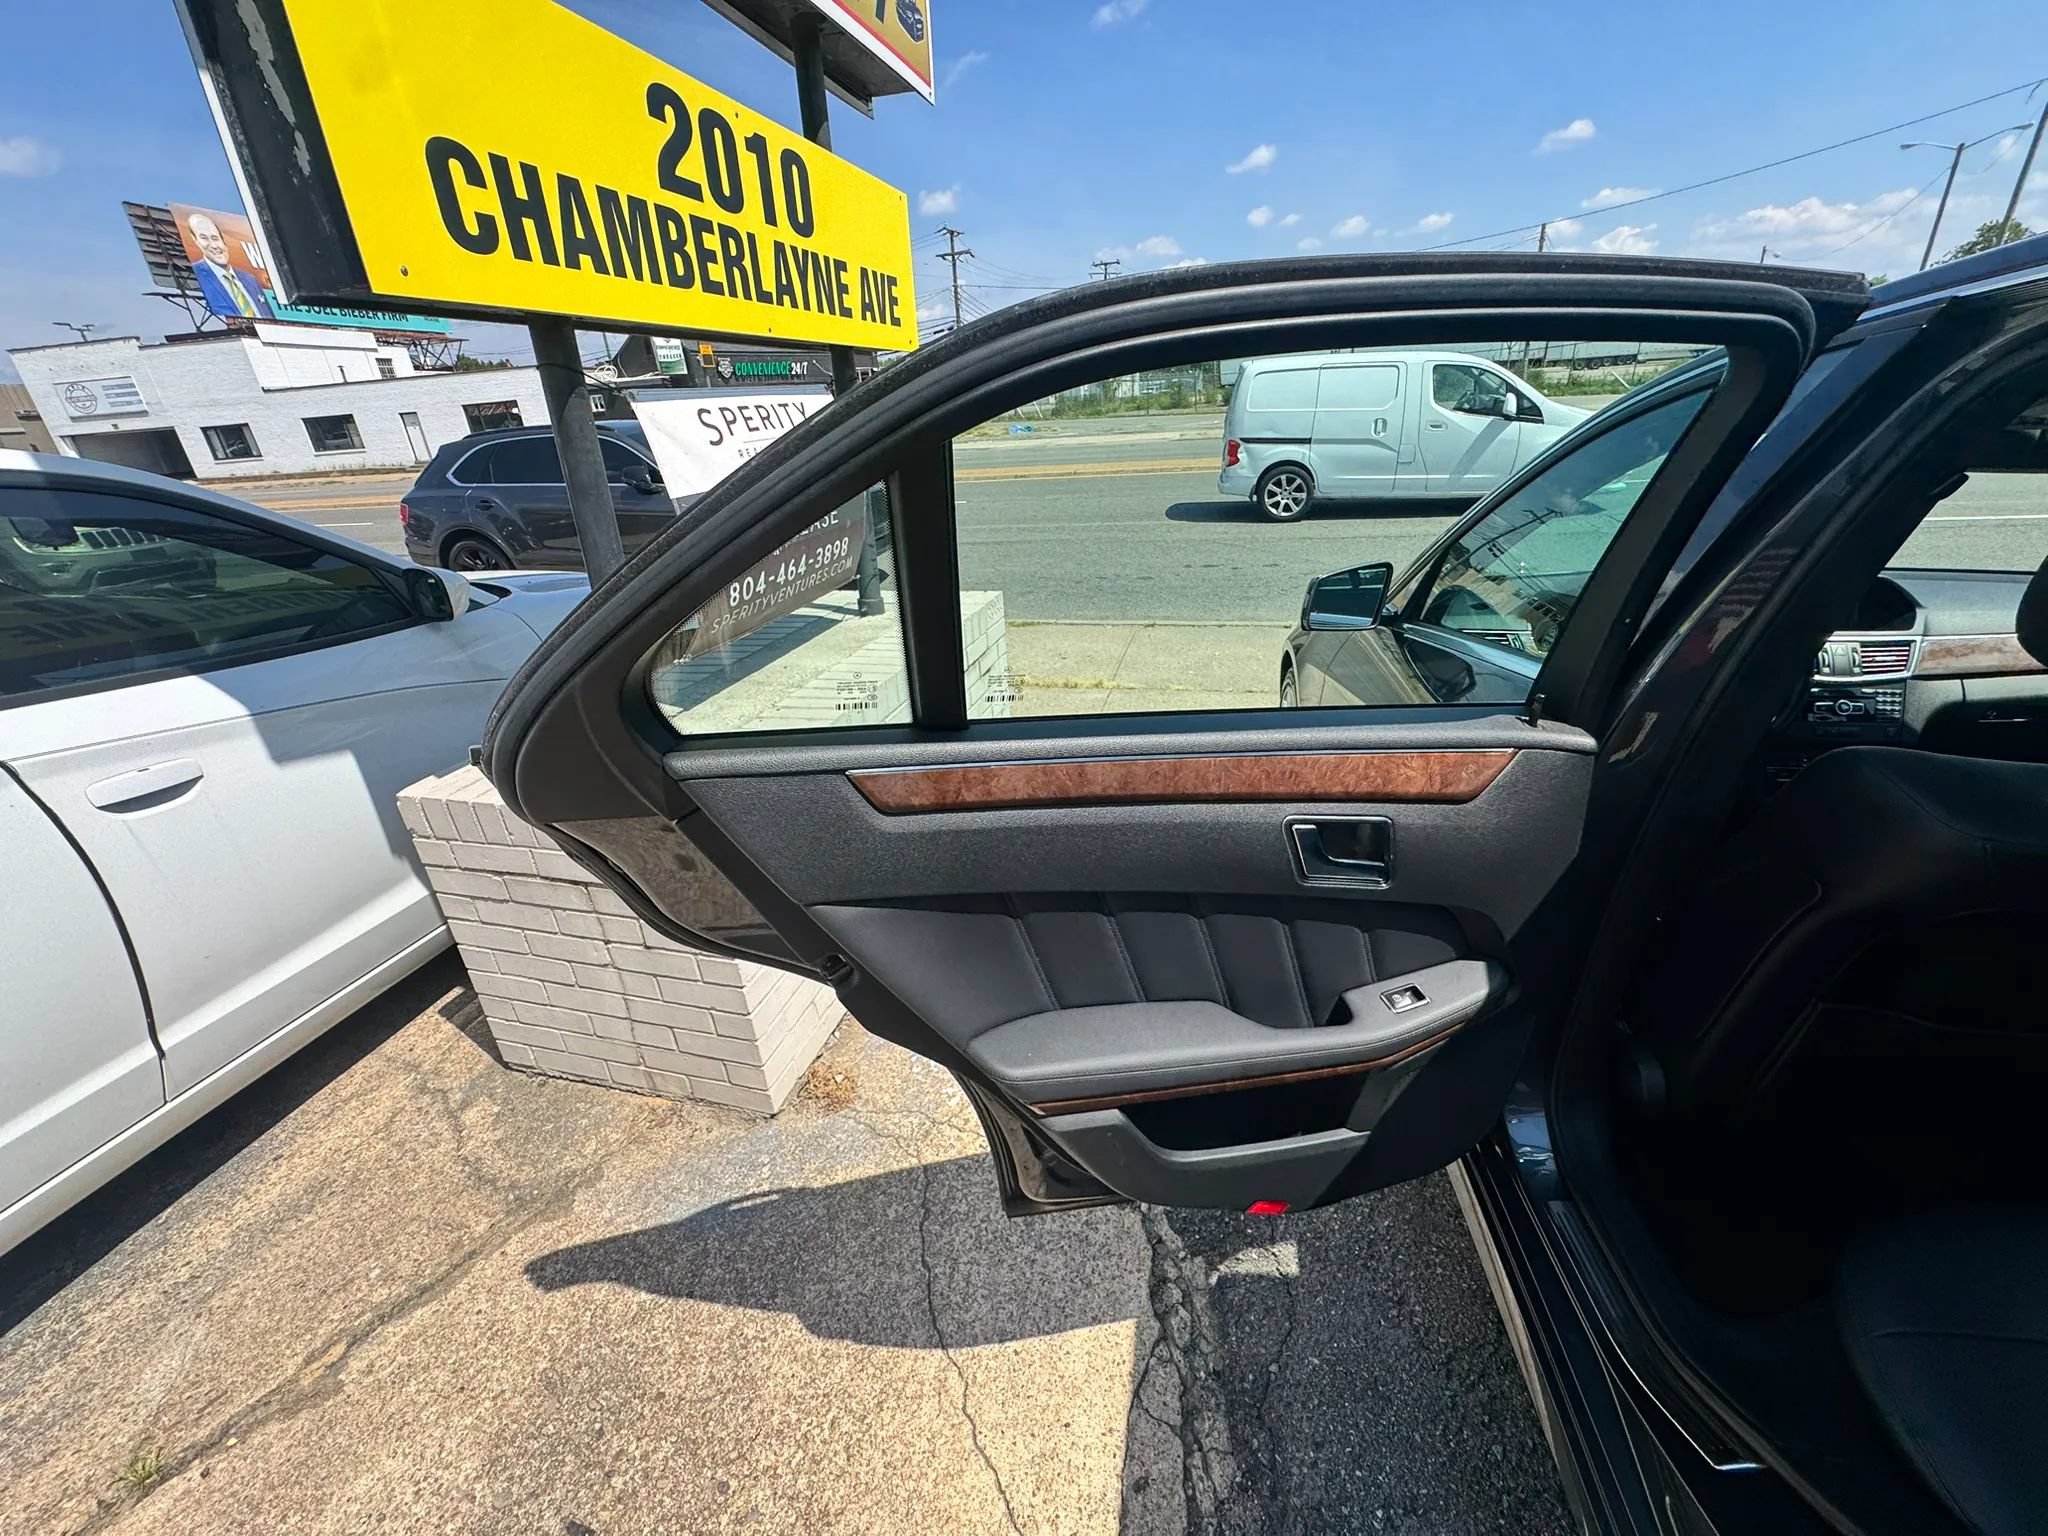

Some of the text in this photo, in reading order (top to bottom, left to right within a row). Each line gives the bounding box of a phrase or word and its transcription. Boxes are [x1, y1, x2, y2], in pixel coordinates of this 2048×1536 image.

[647, 83, 815, 238] 2010
[426, 137, 902, 327] CHAMBERLAYNE AVE
[735, 361, 791, 377] CONVENIENCE
[791, 361, 809, 375] 24/7
[697, 401, 809, 446] SPERITY
[710, 555, 853, 634] SPERITYVENTURES.COM
[729, 536, 849, 607] 804-464-3898
